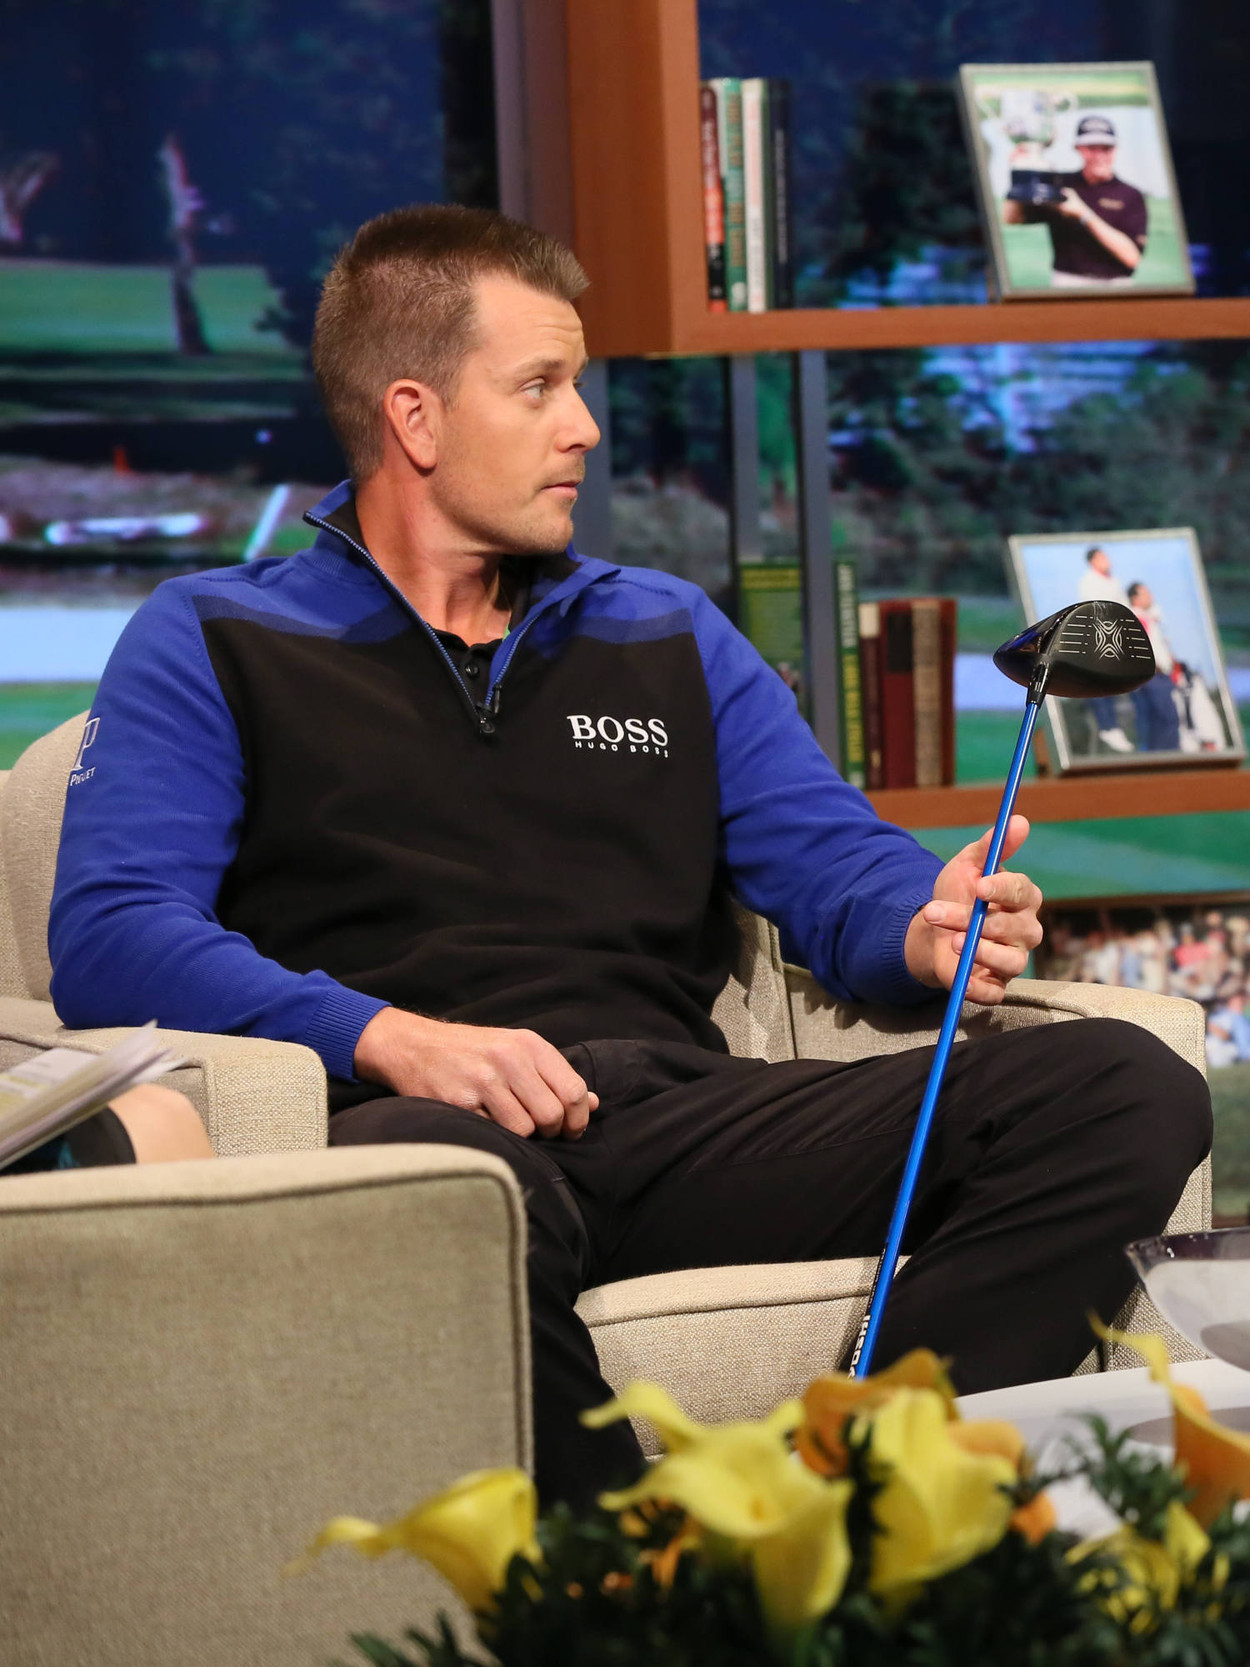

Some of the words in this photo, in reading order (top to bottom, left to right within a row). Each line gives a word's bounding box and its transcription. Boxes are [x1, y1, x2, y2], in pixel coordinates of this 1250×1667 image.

[566, 714, 668, 746] BOSS
[575, 741, 619, 752] HUGO
[630, 744, 669, 758] BOSS
